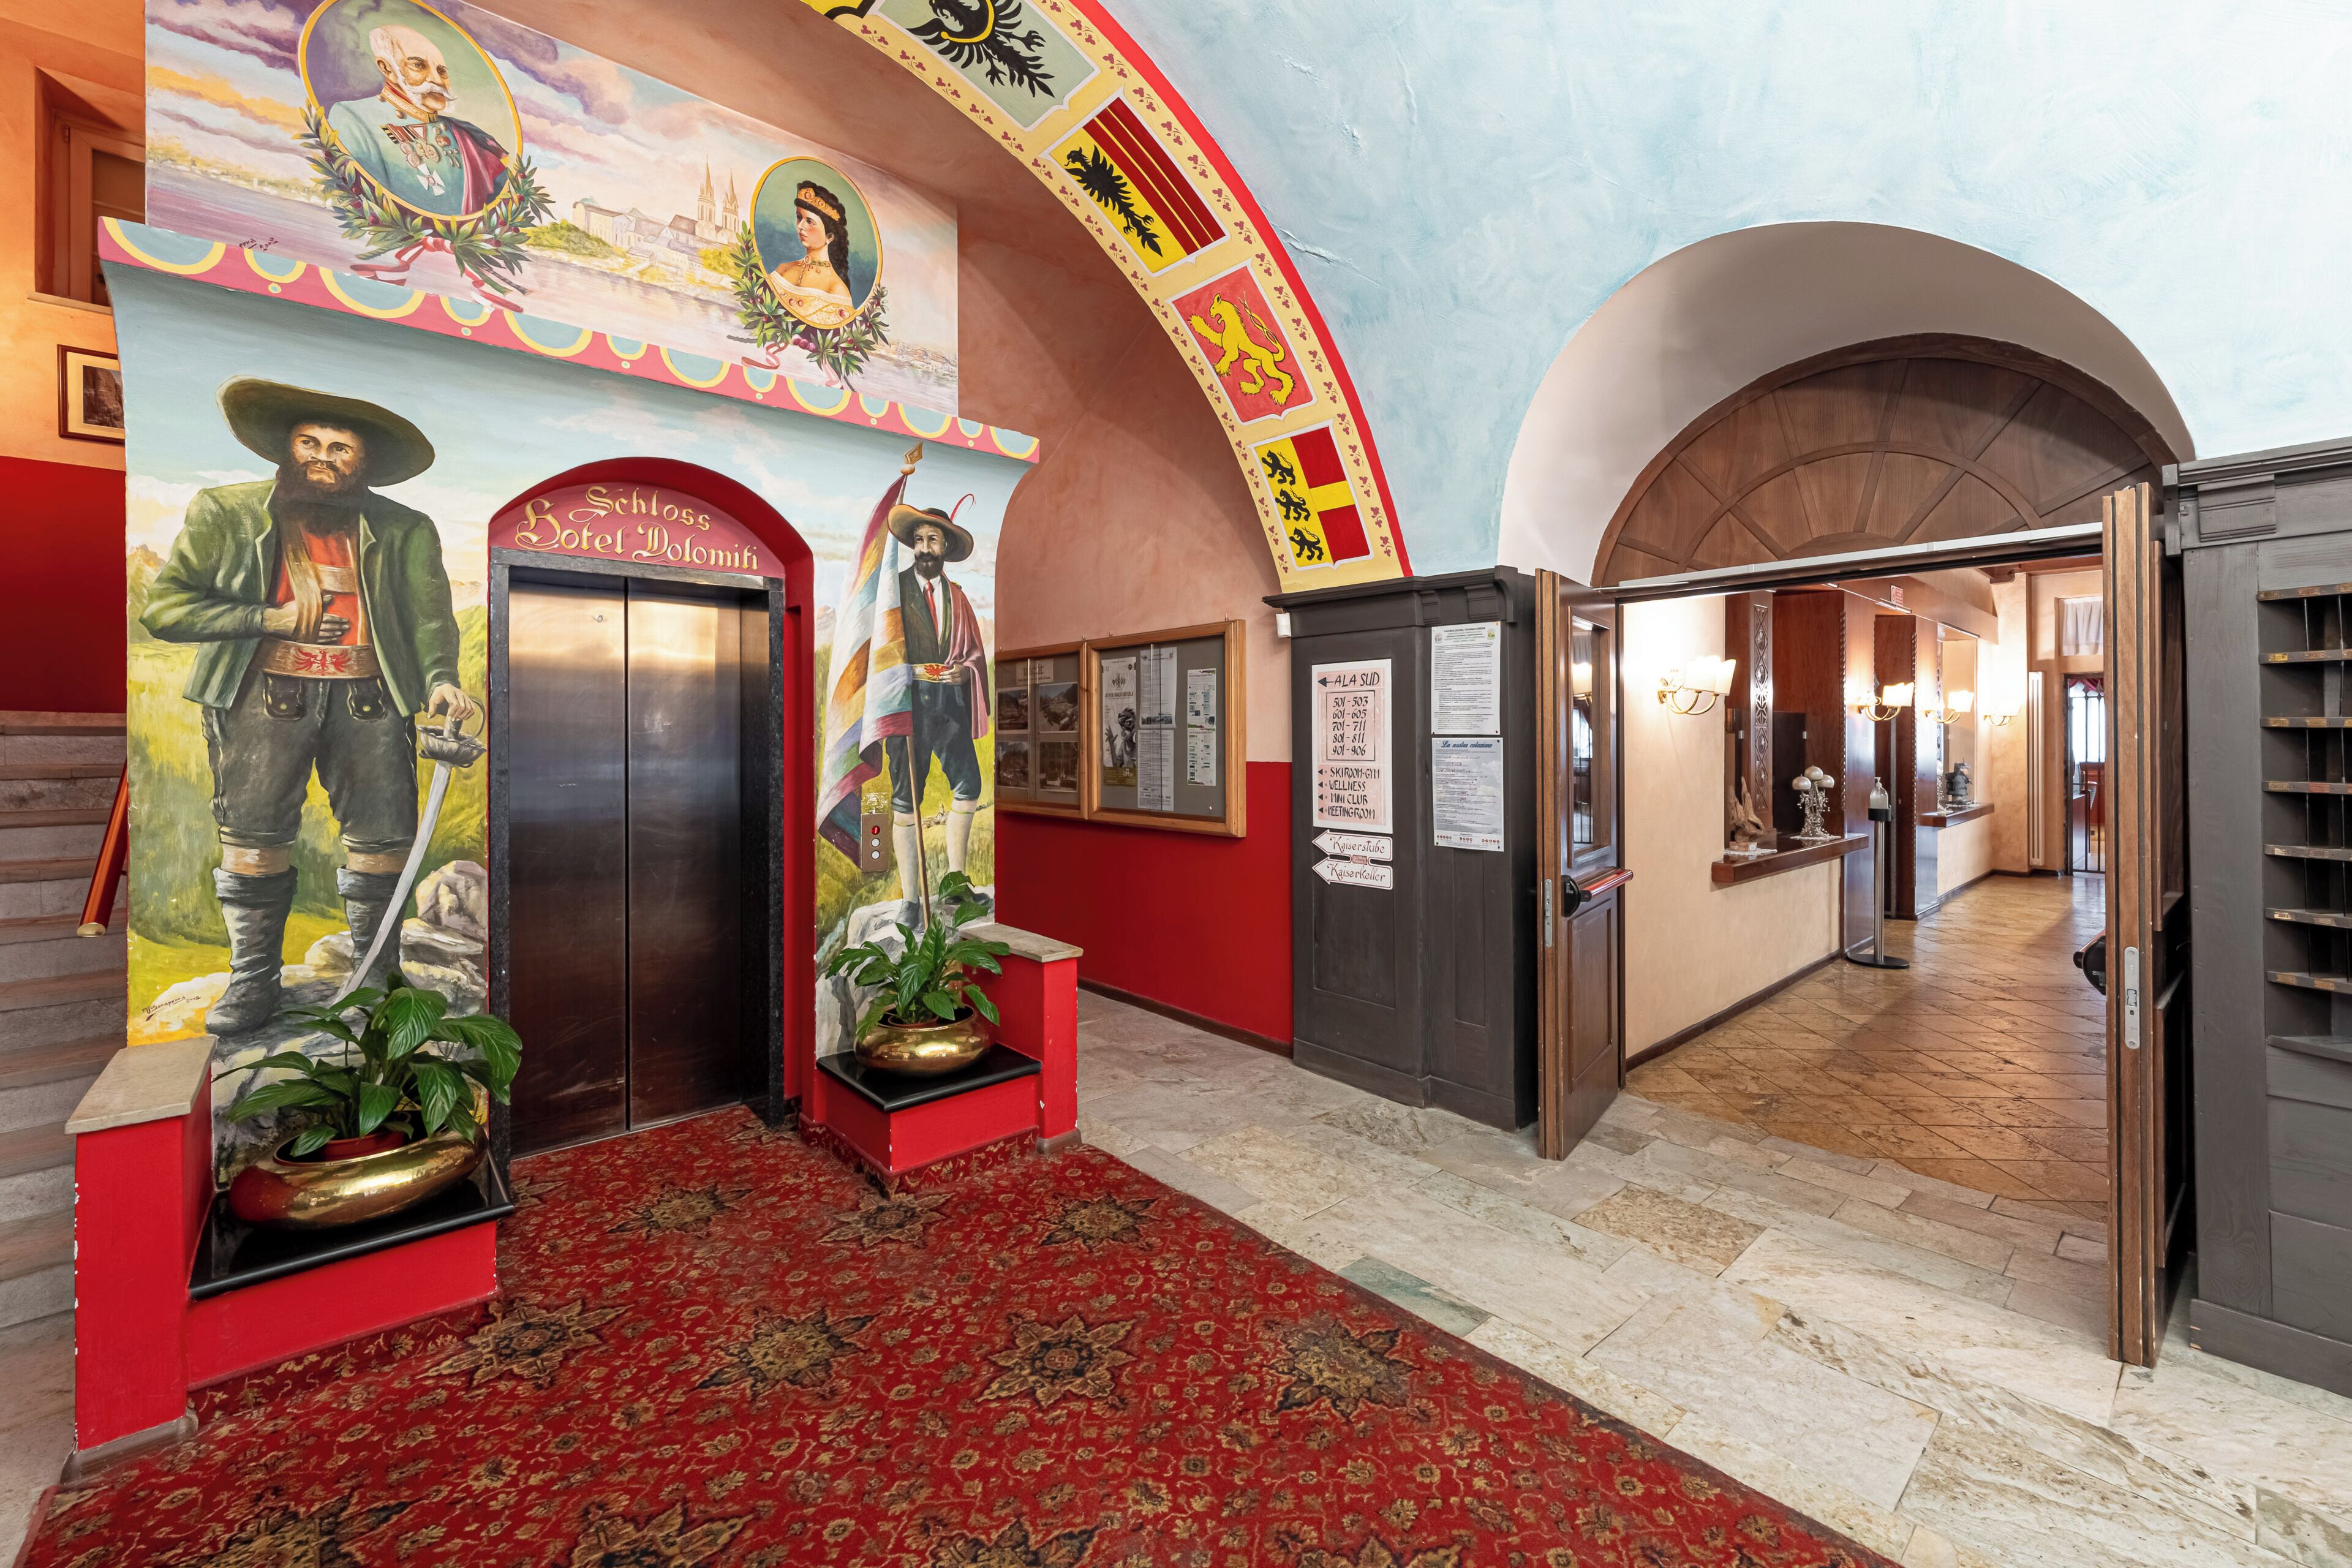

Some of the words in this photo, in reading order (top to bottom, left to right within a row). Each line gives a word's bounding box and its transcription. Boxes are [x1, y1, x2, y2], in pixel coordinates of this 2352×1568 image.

[568, 486, 710, 532] Schloss
[514, 499, 626, 554] Hotel
[631, 521, 759, 570] Dolomiti
[1334, 674, 1357, 687] ALA
[1360, 671, 1380, 687] SUD
[1329, 780, 1366, 792] WELLNESS
[1331, 793, 1345, 804] MINI
[1347, 794, 1368, 805] CLUB
[1330, 836, 1385, 854] Kaiserstube
[1327, 863, 1386, 882] Kaiserkeller
